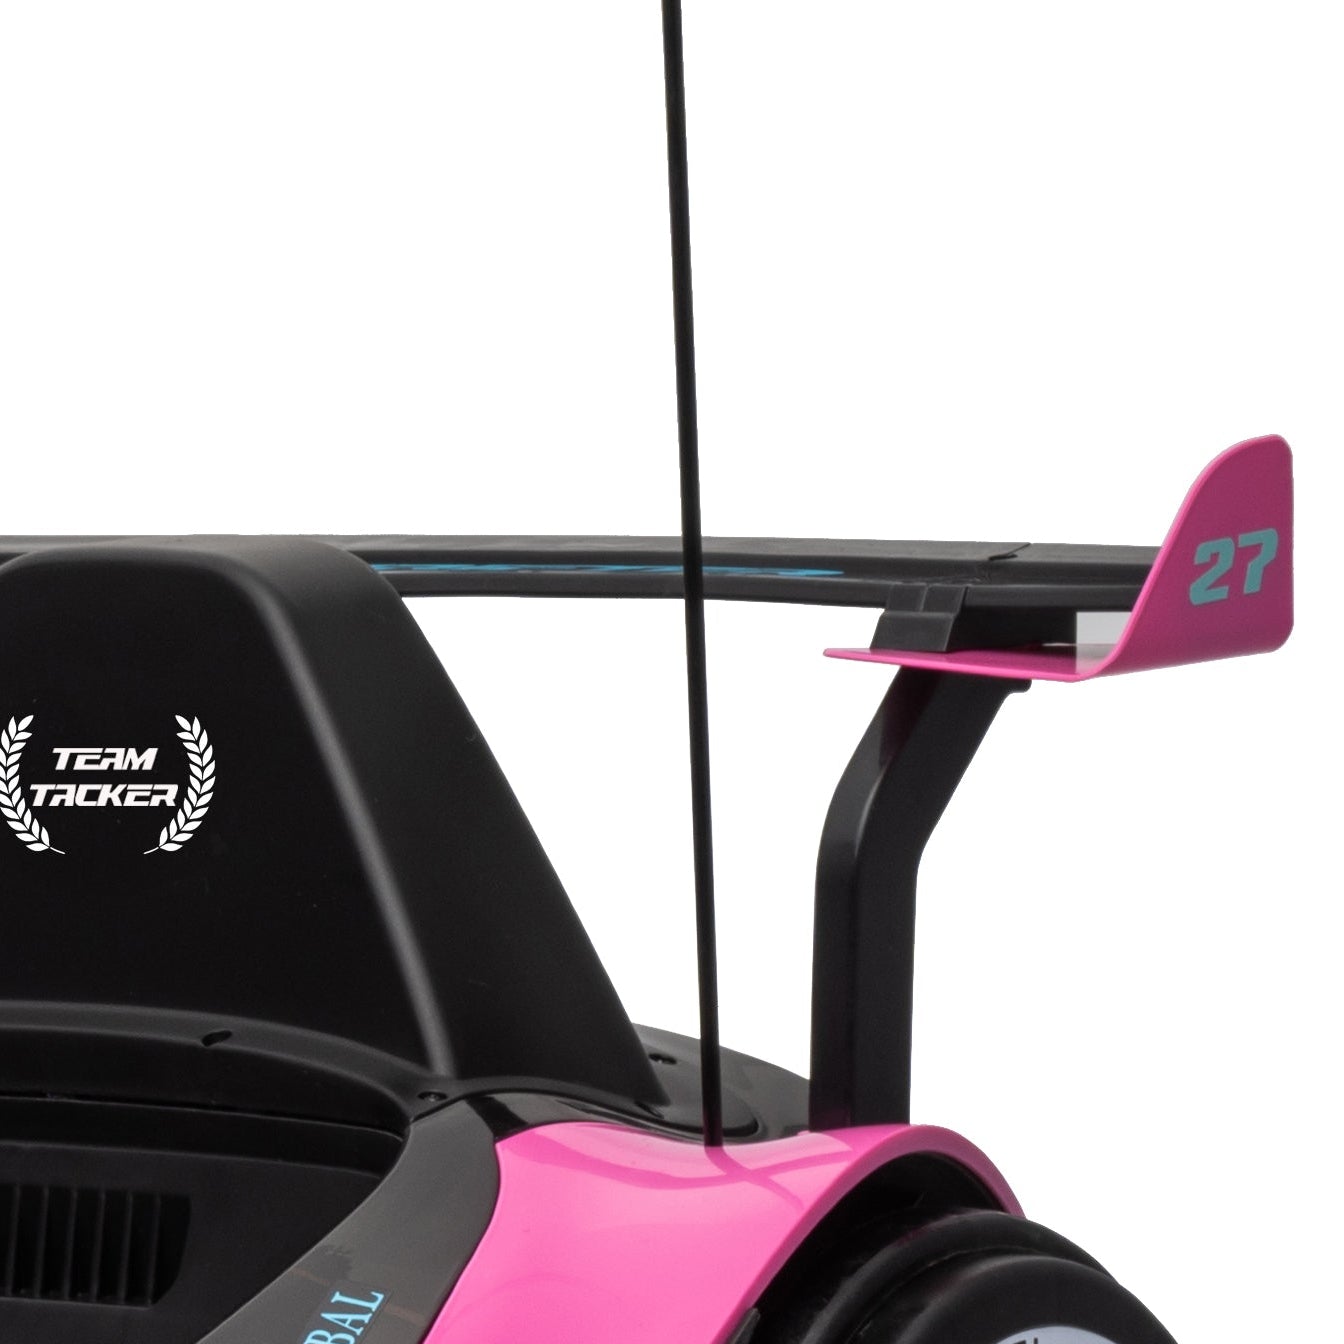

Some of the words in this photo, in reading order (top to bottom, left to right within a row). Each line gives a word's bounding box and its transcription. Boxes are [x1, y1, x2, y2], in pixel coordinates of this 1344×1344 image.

[1188, 527, 1279, 606] 27
[52, 747, 159, 771] TEAM
[29, 783, 179, 807] TACKER
